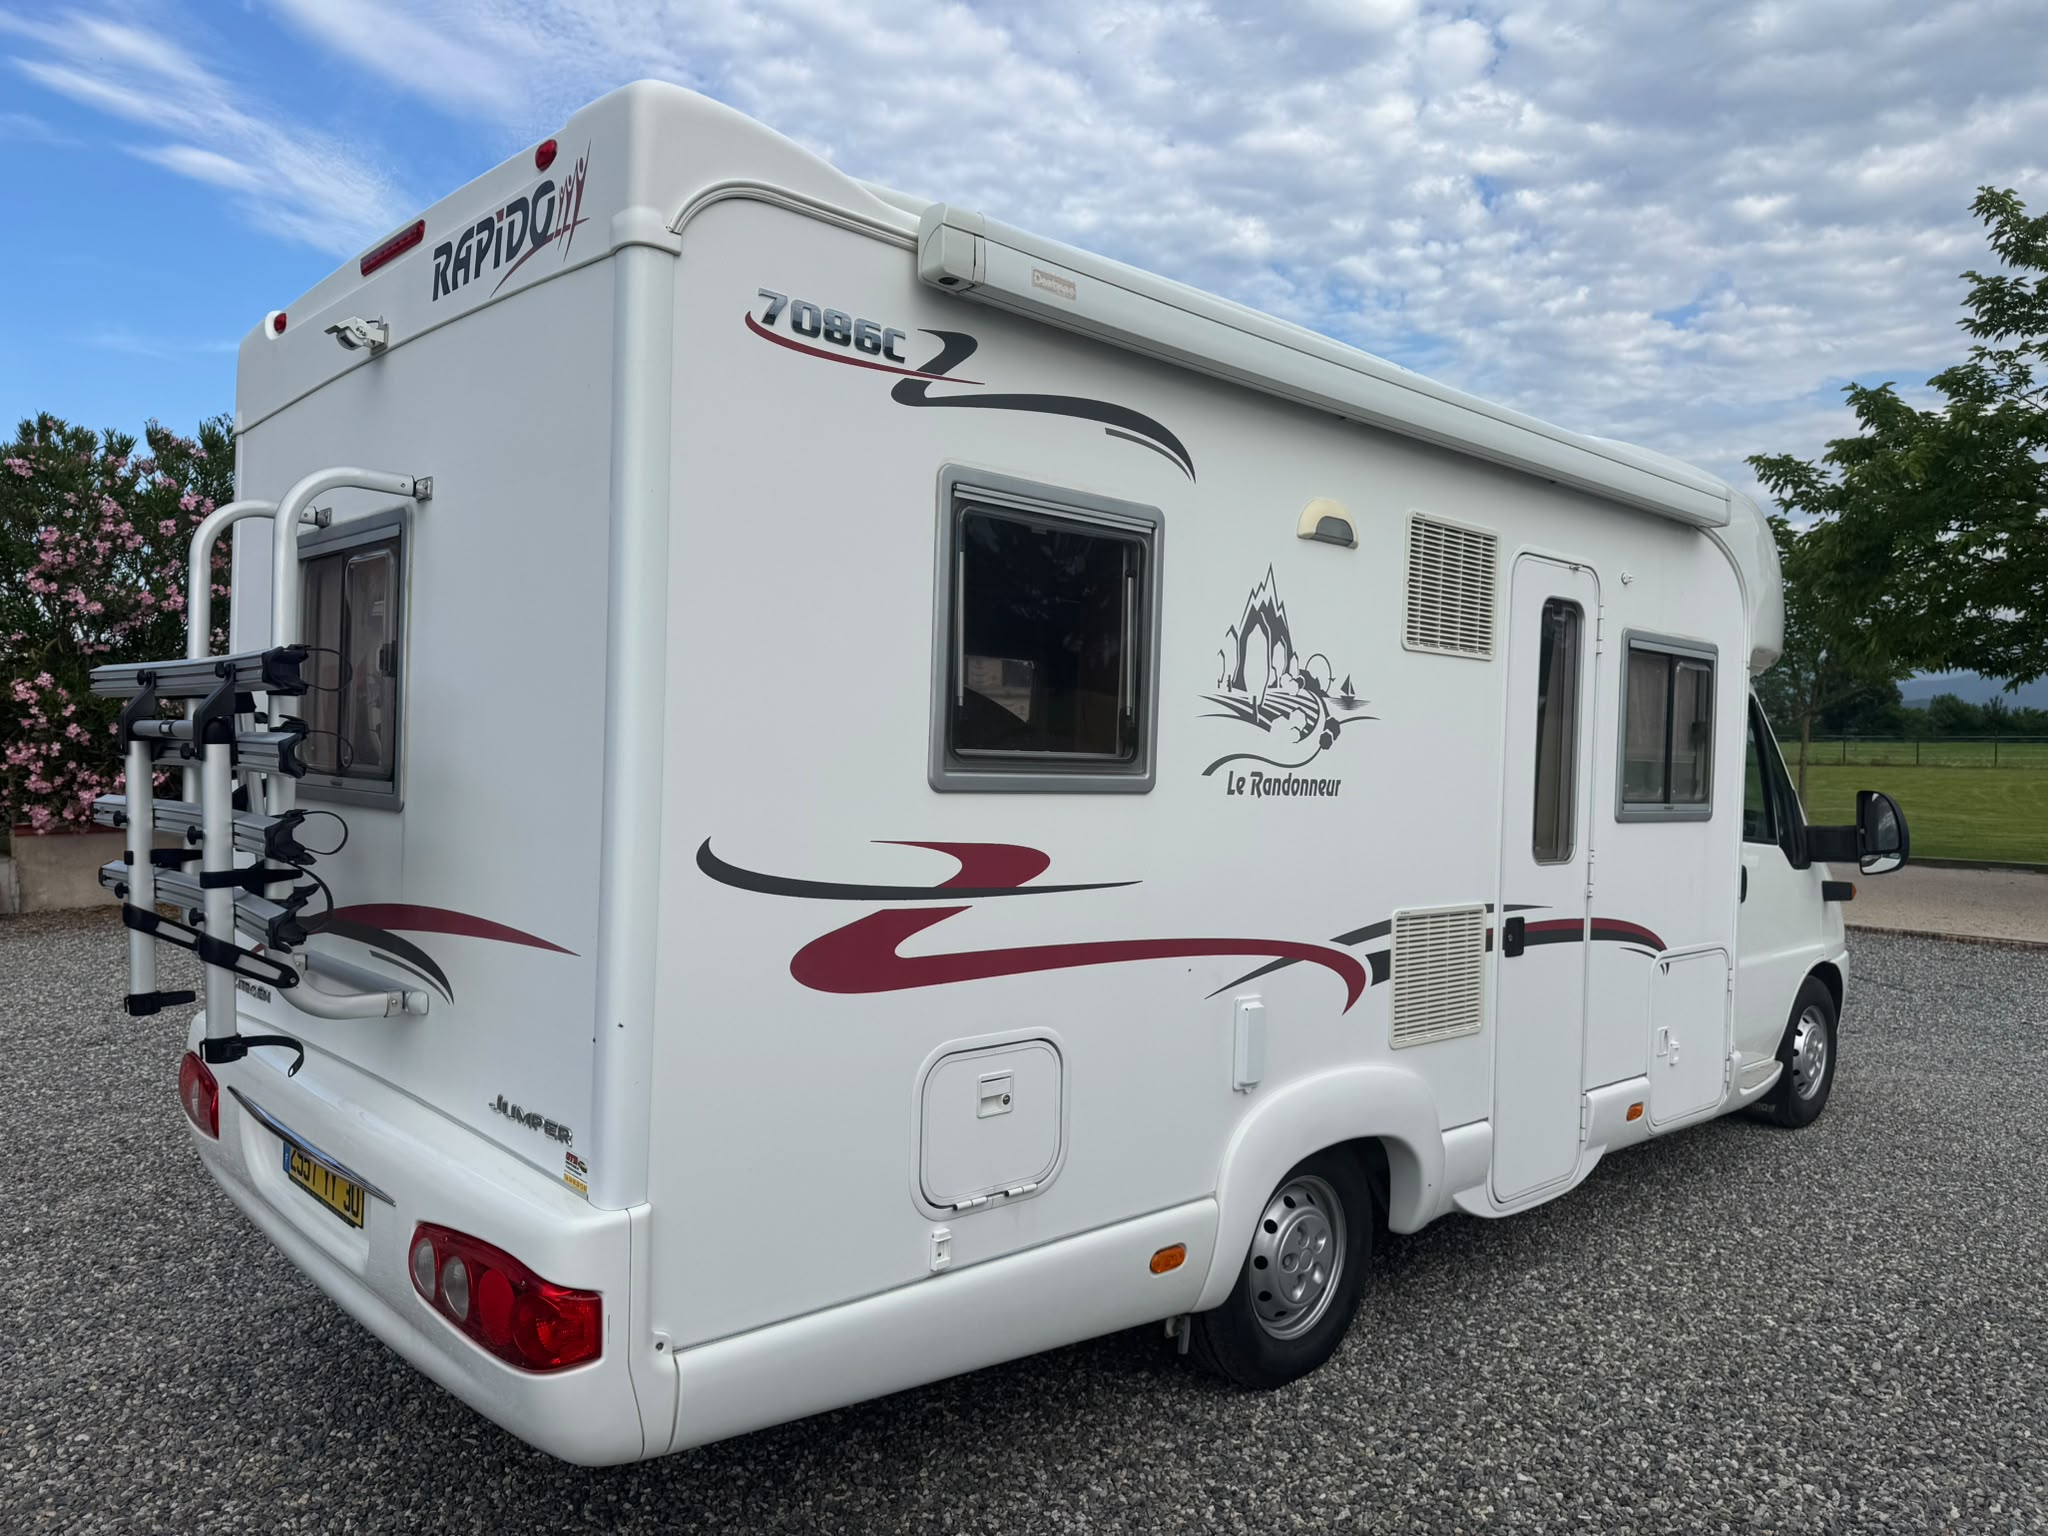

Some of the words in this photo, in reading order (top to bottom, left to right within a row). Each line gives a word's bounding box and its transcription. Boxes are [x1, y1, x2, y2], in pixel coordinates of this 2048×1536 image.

[758, 288, 906, 364] 7086C
[1226, 770, 1246, 796] Le
[1250, 771, 1342, 799] Randonneur
[488, 1094, 573, 1148] JUMPER
